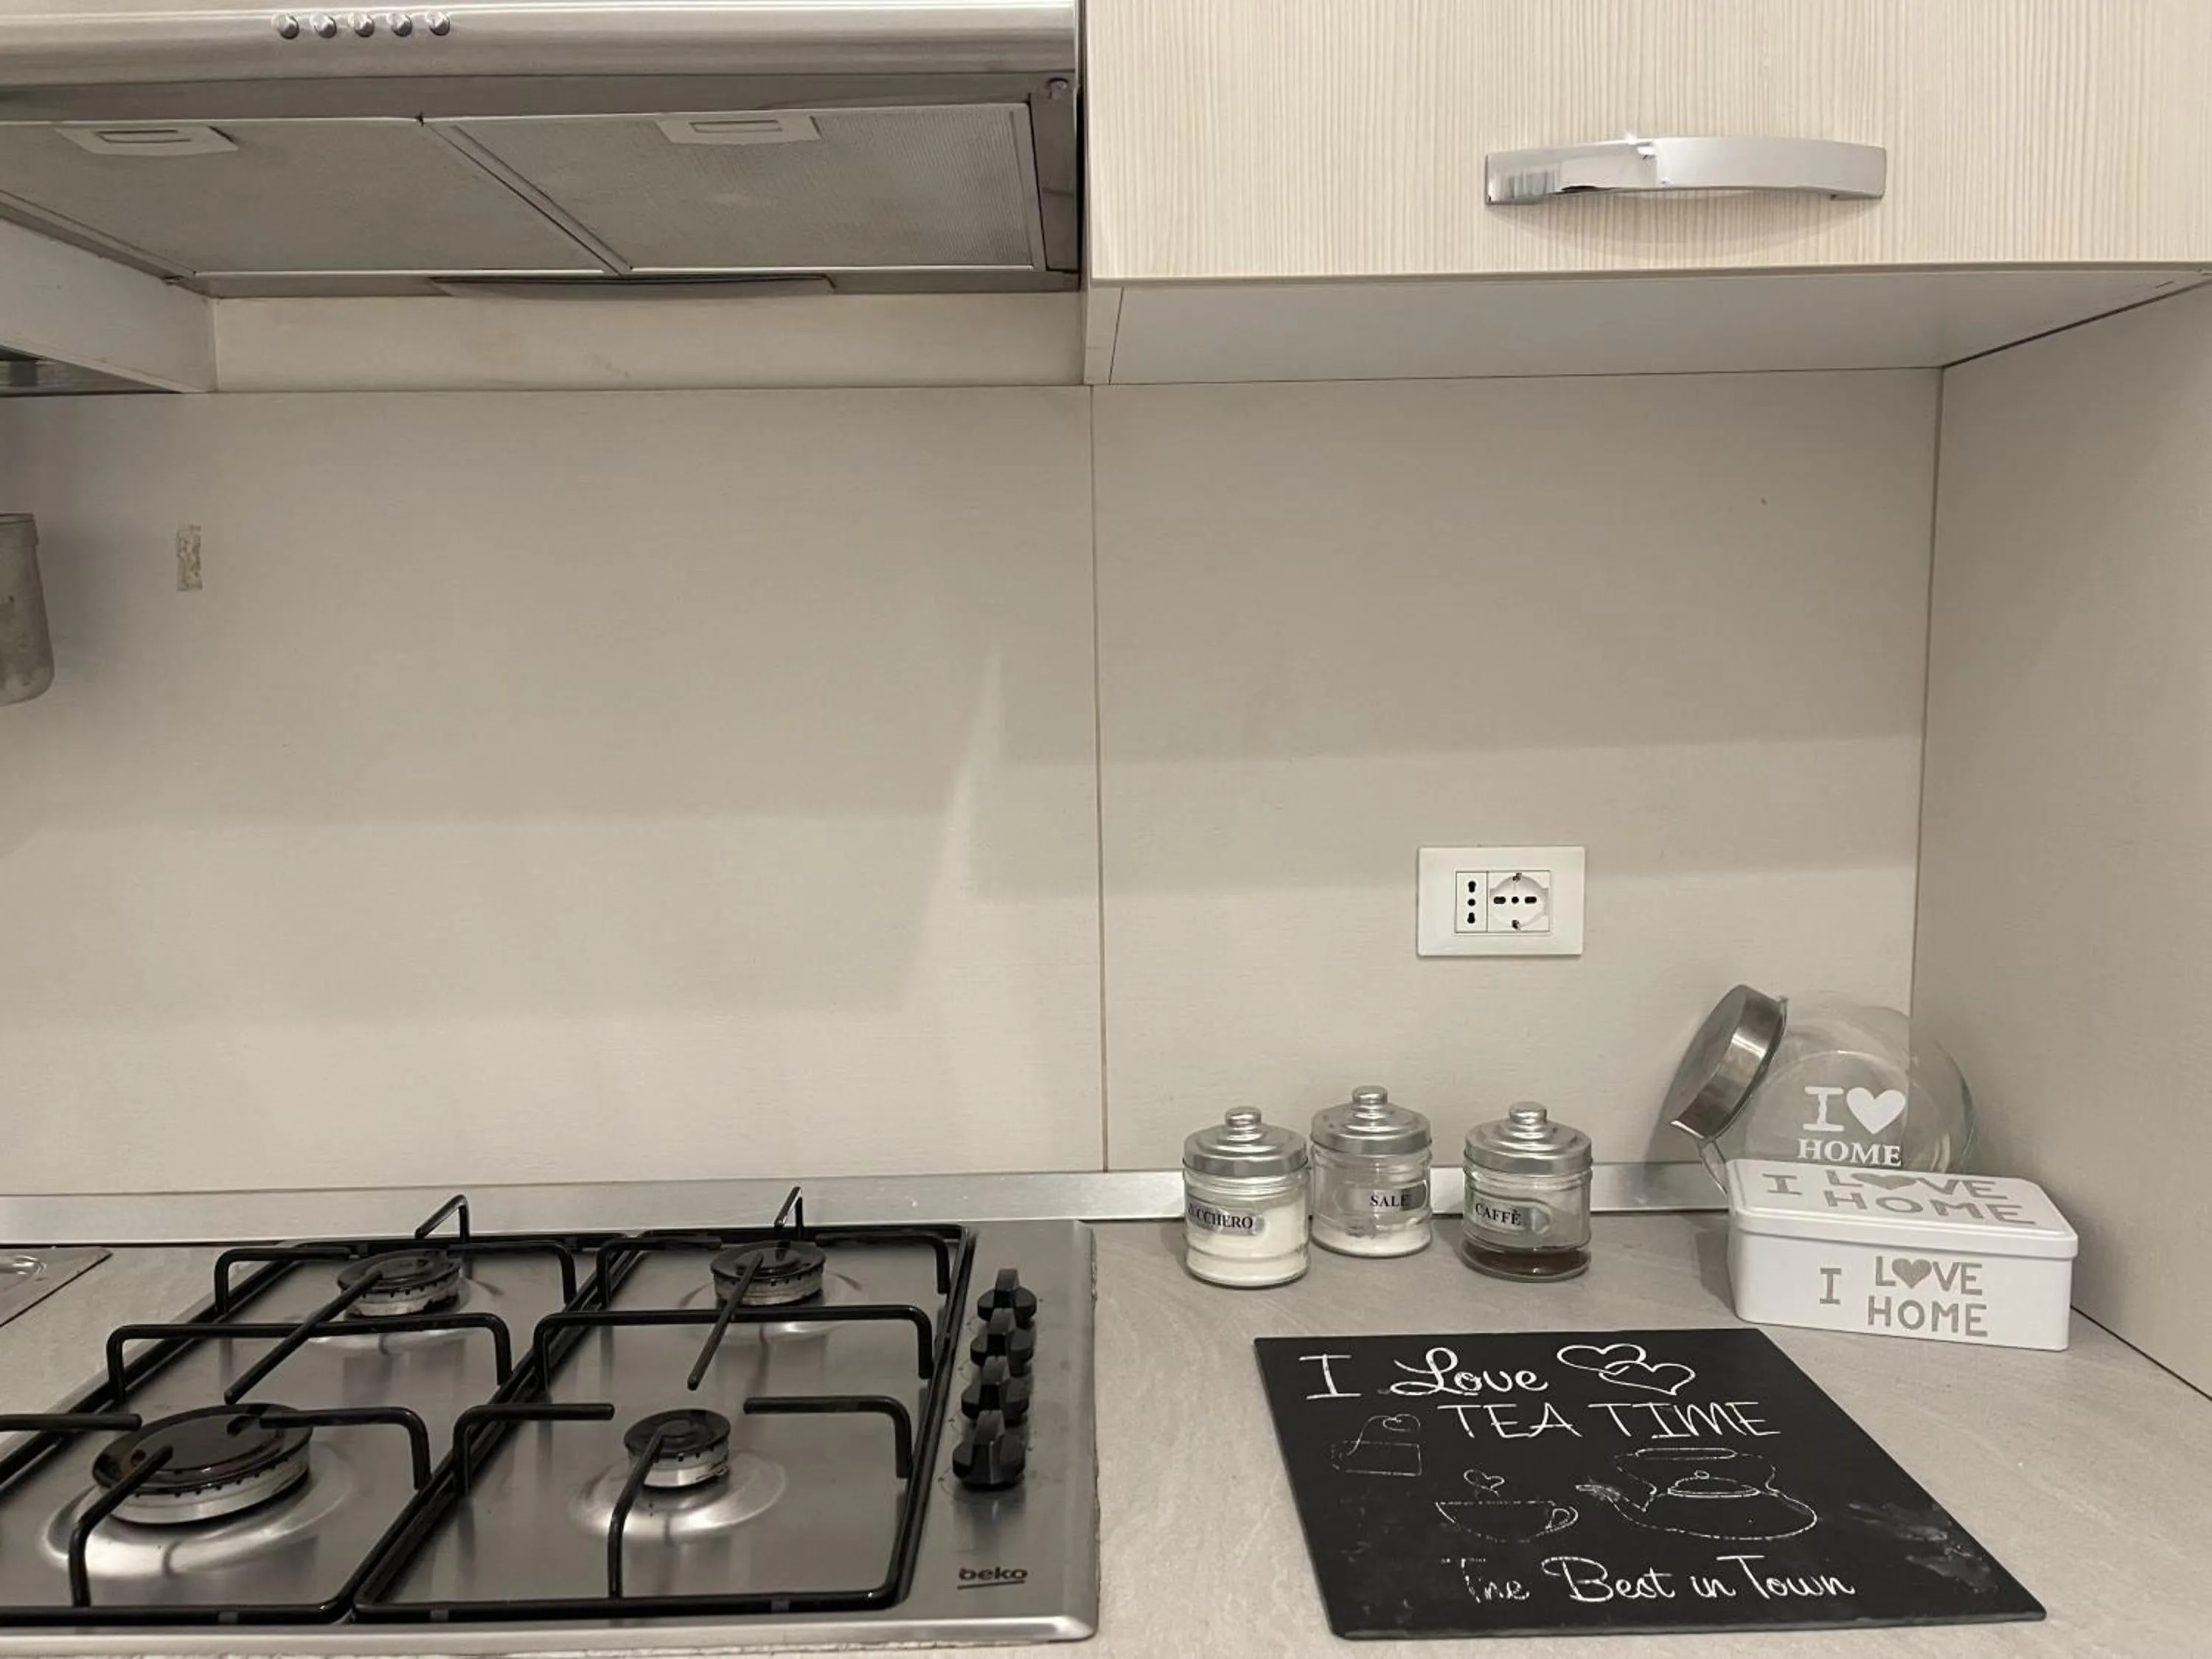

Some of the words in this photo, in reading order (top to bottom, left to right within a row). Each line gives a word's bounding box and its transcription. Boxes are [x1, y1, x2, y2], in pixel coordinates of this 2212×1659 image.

[1803, 1086, 1845, 1132] I
[1796, 1138, 1902, 1167] HOME
[1369, 1194, 1409, 1207] SALE
[1761, 1172, 1803, 1196] I
[1823, 1190, 2036, 1225] HOME
[1819, 1267, 1841, 1305] I
[1868, 1295, 1988, 1338] HOME
[1299, 1354, 1363, 1400] I
[1390, 1346, 1549, 1397] Love
[1437, 1402, 1582, 1439] TEA
[1587, 1401, 1781, 1439] TIME
[959, 1566, 1028, 1581] beko
[1541, 1556, 1675, 1603] Best
[1690, 1575, 1736, 1598] in
[1716, 1554, 1856, 1599] Town
